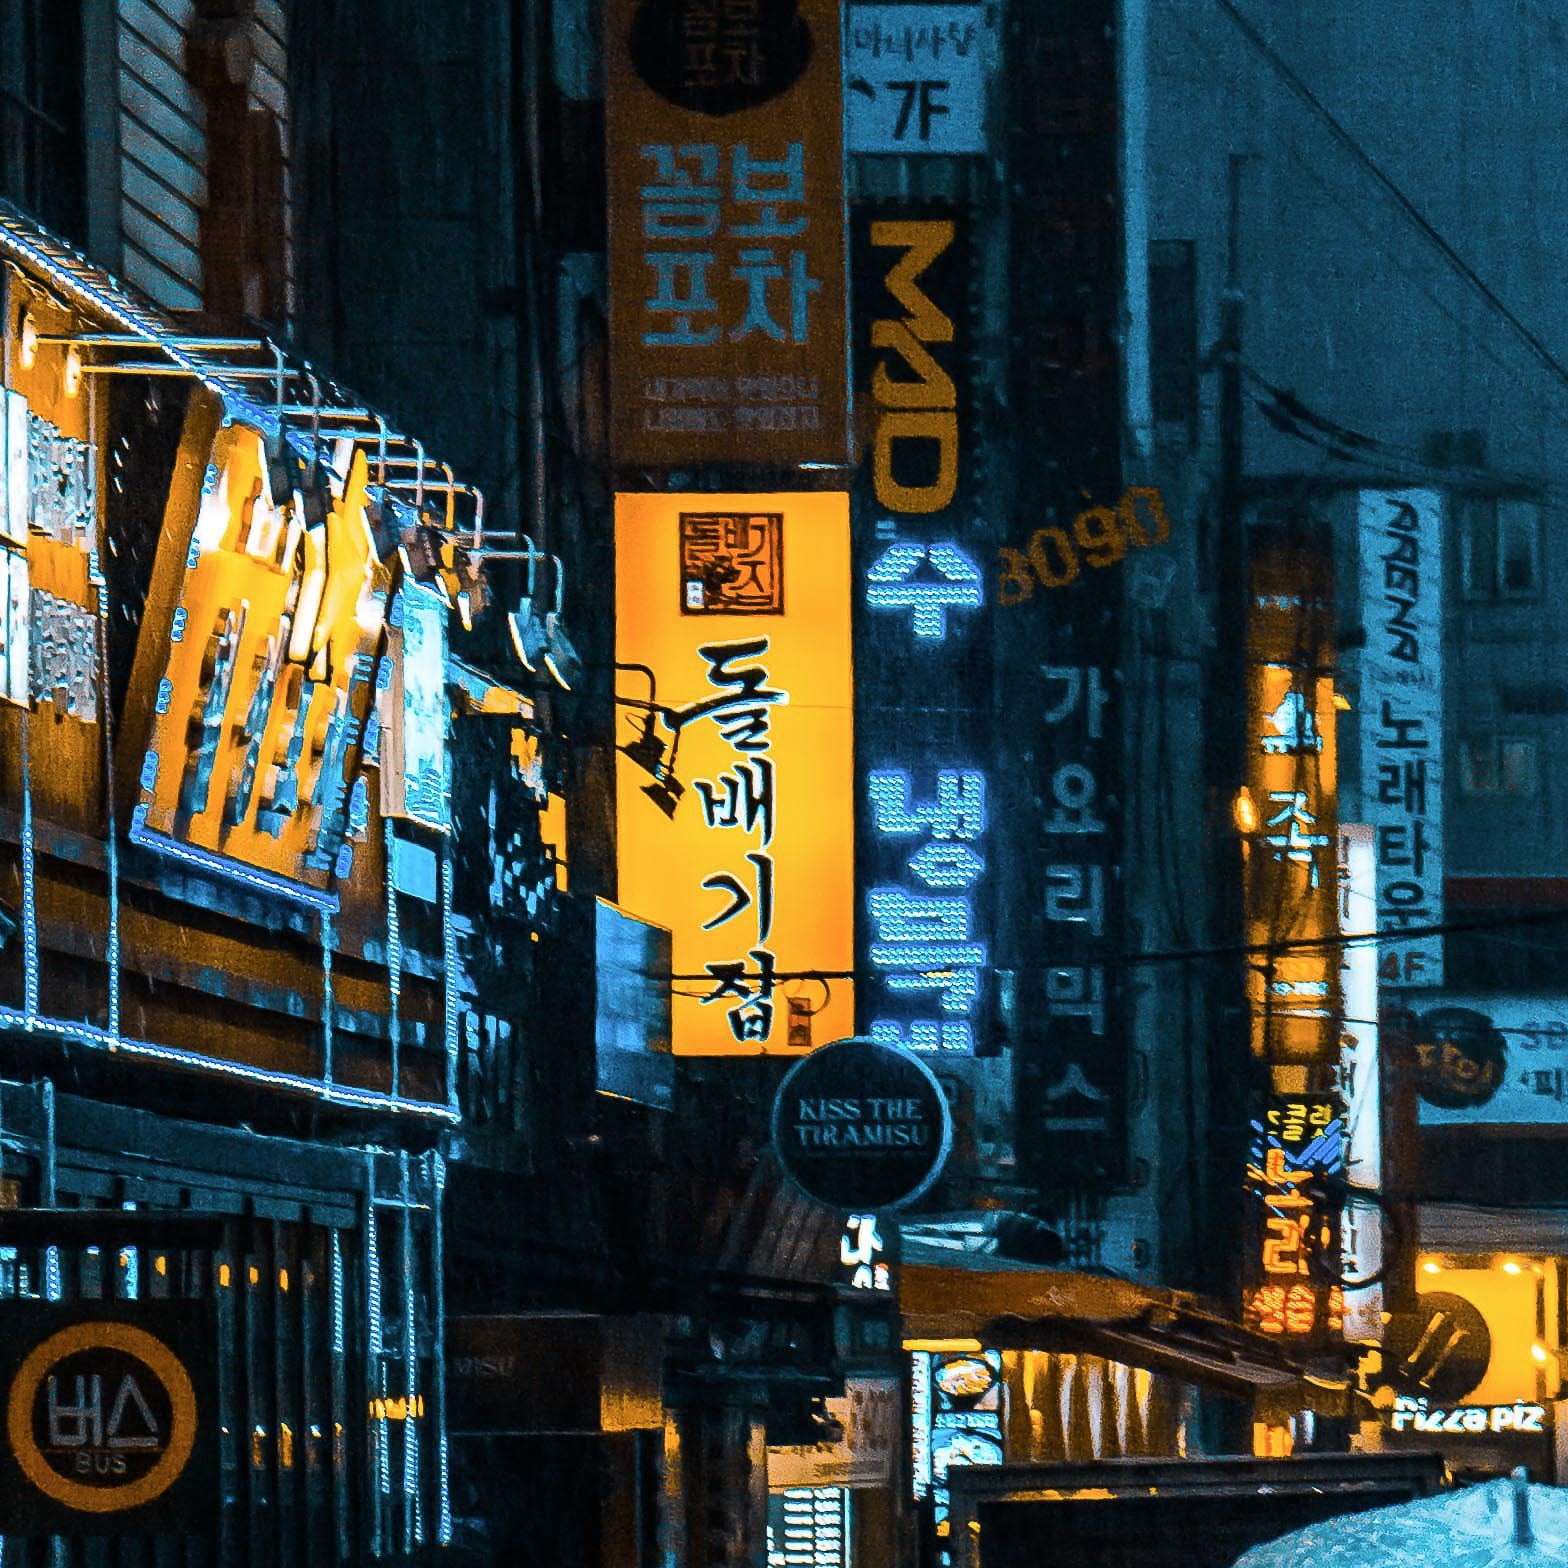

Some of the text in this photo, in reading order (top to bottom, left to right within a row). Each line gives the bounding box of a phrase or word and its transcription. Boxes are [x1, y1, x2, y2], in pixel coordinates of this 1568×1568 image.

[885, 80, 951, 141] 7F
[641, 248, 823, 347] 포차
[870, 220, 957, 514] MAD
[1042, 664, 1109, 1133] 가요리믹스
[794, 1124, 929, 1147] TIRAMISU
[799, 1097, 922, 1121] KISS THE
[74, 1452, 128, 1475] BUS
